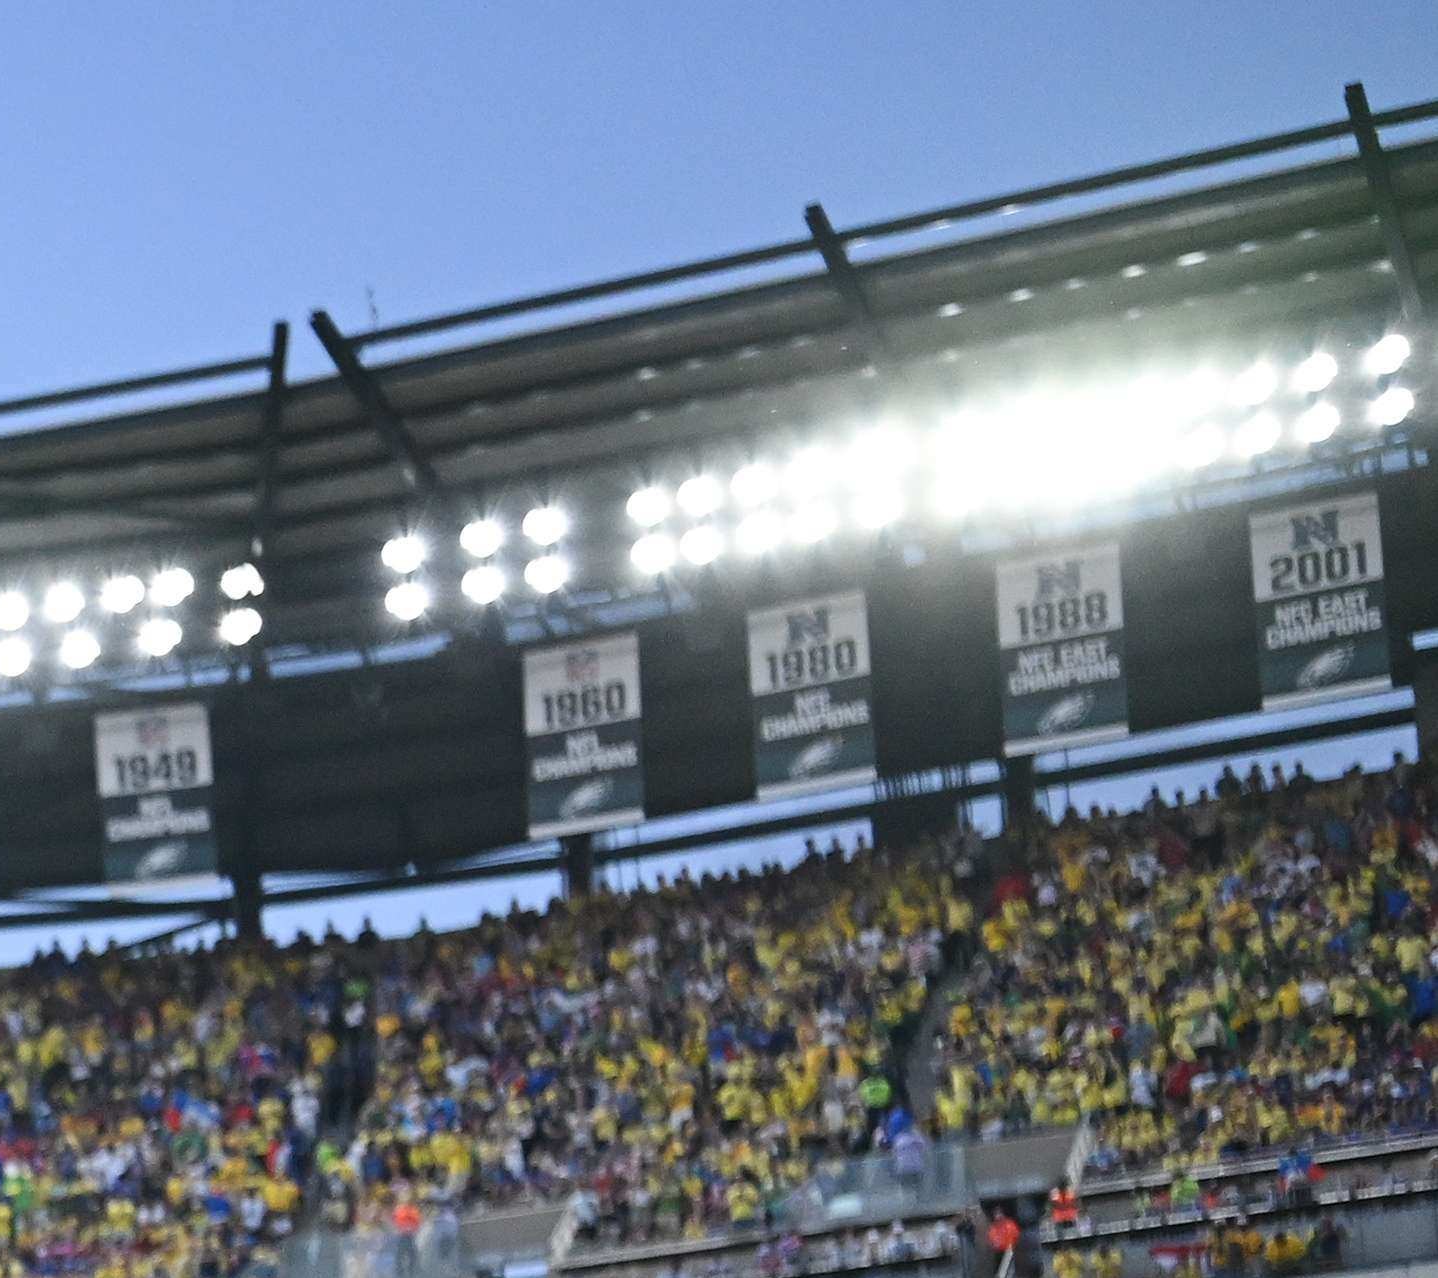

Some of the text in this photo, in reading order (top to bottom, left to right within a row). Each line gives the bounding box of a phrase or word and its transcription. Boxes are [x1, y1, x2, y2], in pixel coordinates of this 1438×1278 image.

[1270, 541, 1367, 592] 2001
[1016, 590, 1107, 641] 1988
[767, 639, 857, 690] 1980
[543, 678, 626, 730] 1960
